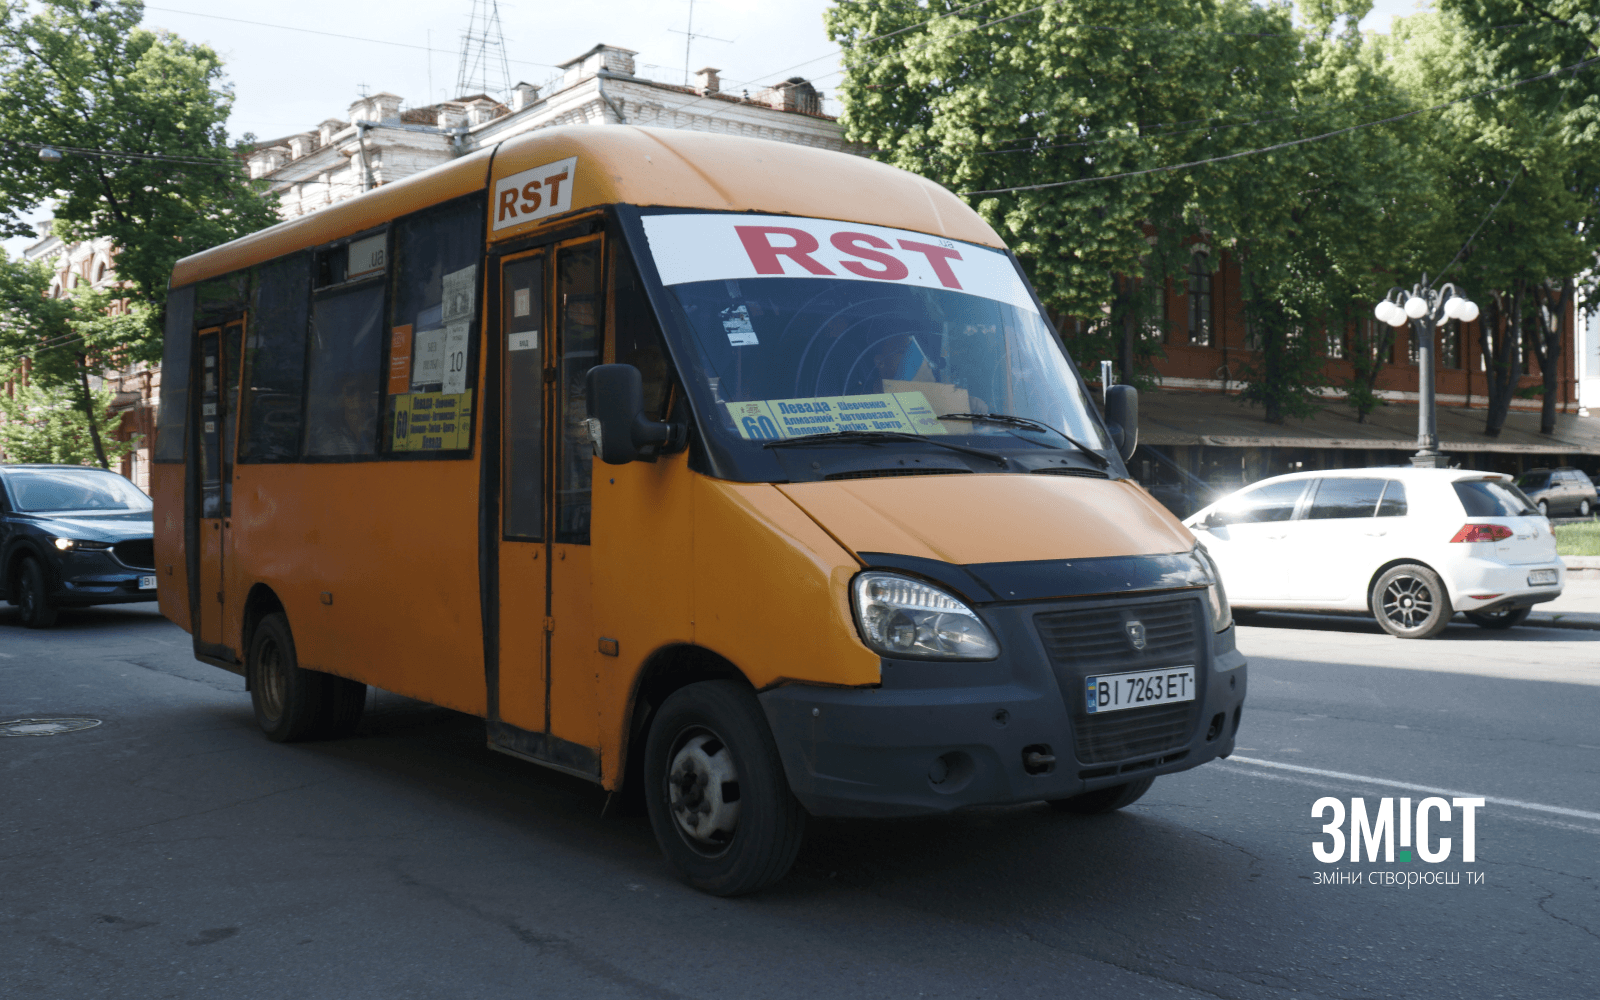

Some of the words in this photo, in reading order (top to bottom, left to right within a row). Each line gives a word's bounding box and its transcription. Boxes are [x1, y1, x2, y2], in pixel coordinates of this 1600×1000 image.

[498, 171, 568, 222] RST
[368, 250, 384, 268] .ua
[733, 225, 964, 291] RST
[450, 351, 463, 372] 10
[777, 402, 831, 415] Левада
[837, 401, 887, 411] Шевченка
[783, 414, 834, 425] Алмазний
[838, 411, 895, 421] Автовокзал
[396, 410, 408, 439] 60
[741, 415, 780, 439] 60
[787, 424, 832, 435] Половки
[872, 421, 903, 430] Центр
[144, 577, 154, 586] BI
[1098, 680, 1119, 707] BI
[1126, 675, 1163, 704] 7263
[1166, 672, 1189, 698] ET
